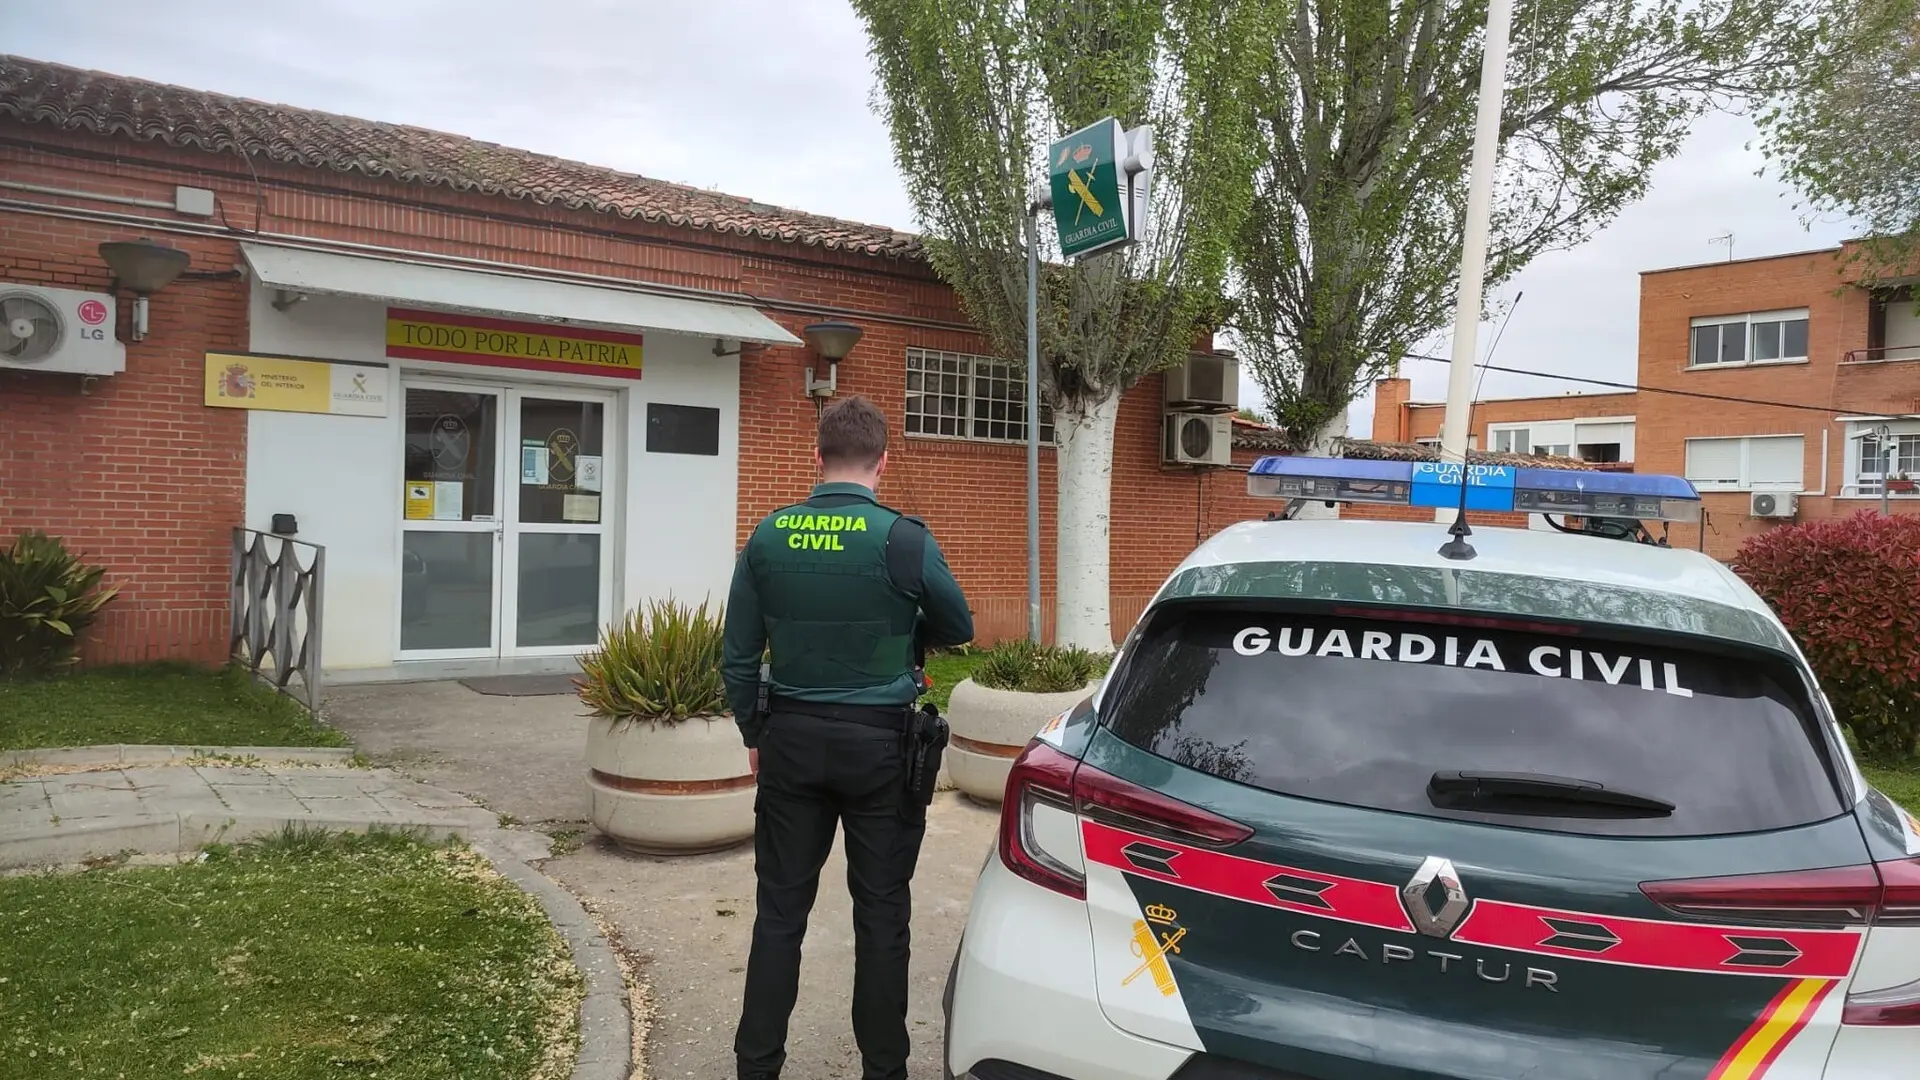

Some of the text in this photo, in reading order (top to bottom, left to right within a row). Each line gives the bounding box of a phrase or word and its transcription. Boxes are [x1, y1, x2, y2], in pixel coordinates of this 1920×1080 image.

[1065, 217, 1118, 244] GUARDIA CIVIL
[80, 328, 104, 340] LG
[402, 324, 630, 365] TODO POR LA PATRIA
[260, 373, 298, 382] MINISTERIO
[1420, 463, 1506, 476] GUARDIA
[1438, 474, 1487, 485] CIVIL
[775, 515, 867, 532] GUARDIA
[788, 533, 844, 551] CIVIL
[1232, 626, 1693, 698] GUARDIA CIVIL
[1290, 930, 1560, 993] CAPTUR
